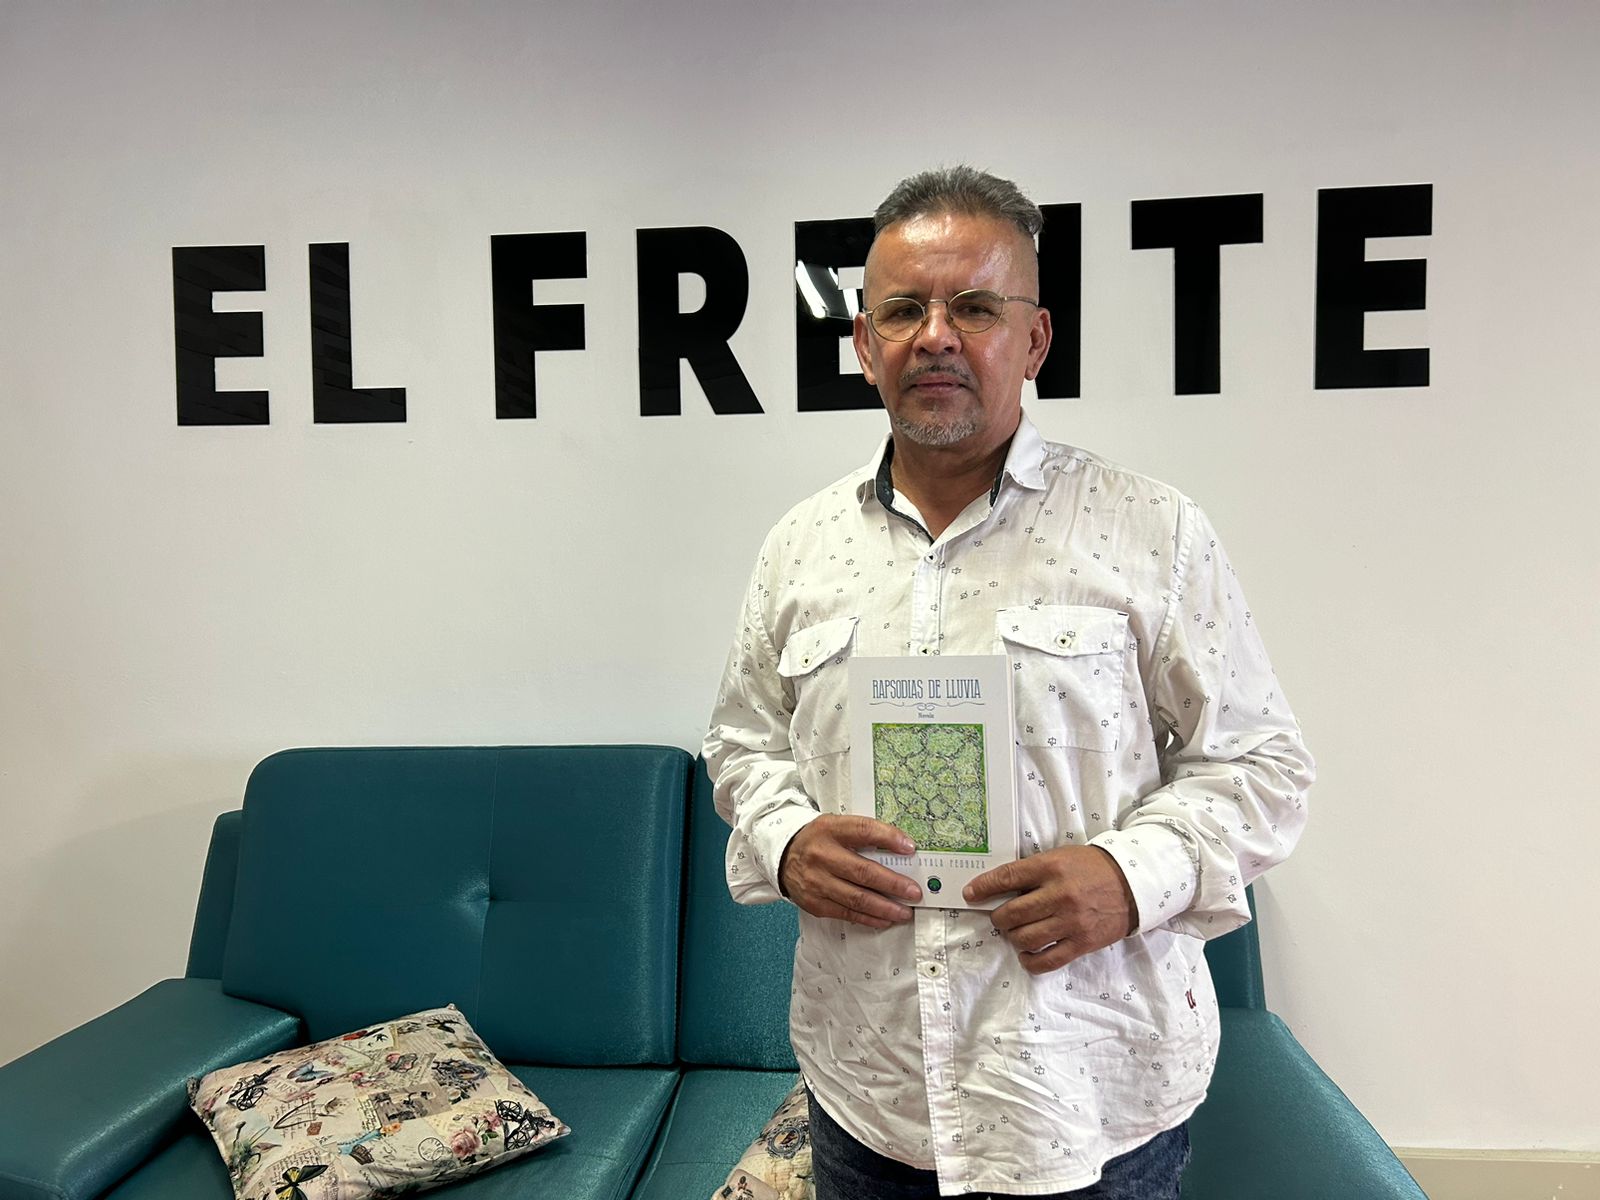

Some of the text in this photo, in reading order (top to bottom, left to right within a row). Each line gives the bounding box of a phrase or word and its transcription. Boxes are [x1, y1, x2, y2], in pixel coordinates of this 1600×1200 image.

[172, 241, 406, 426] EL
[872, 679, 982, 699] RAPSODIAS DE LLUVIA
